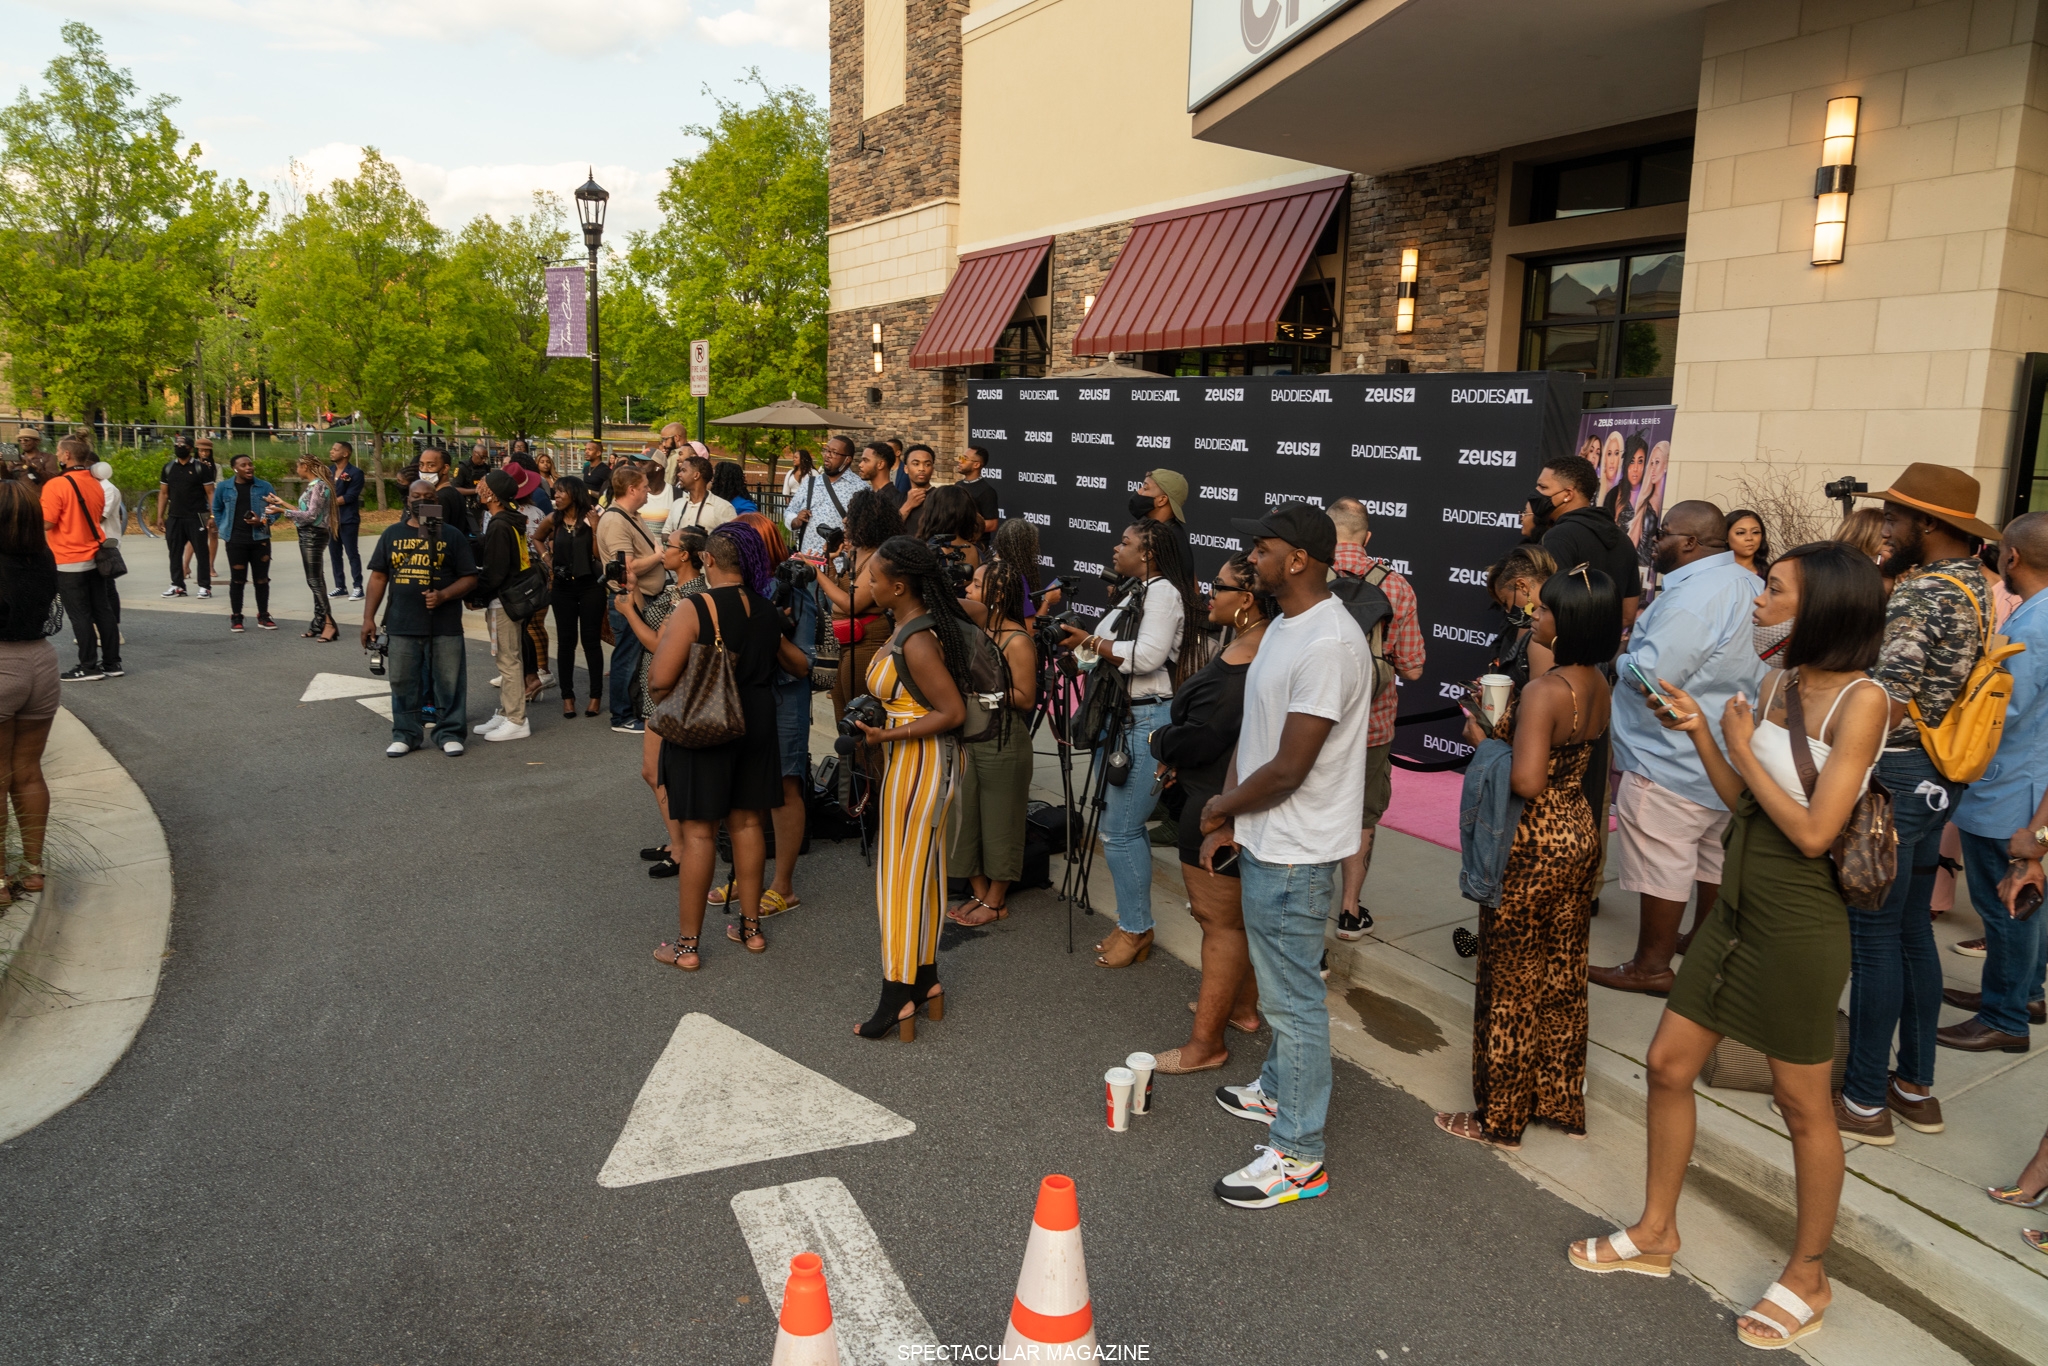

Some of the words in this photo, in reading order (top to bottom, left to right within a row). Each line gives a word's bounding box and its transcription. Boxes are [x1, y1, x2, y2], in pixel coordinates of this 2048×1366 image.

[1019, 389, 1060, 401] BADDIESATL
[1131, 389, 1181, 402] BADDIESATL
[1270, 388, 1333, 403] BADDIESATL
[1450, 388, 1534, 404] BADDIESATL
[1614, 418, 1640, 426] ORIGINAL
[971, 428, 1008, 440] BADDIESATL
[1071, 432, 1115, 446] BADDIESATL
[1194, 437, 1249, 452] BADDIESATL
[1350, 443, 1422, 461] BADDIESATL
[980, 467, 996, 479] eus
[1018, 471, 1058, 485] BADDIESATL
[1442, 507, 1523, 529] BADDIESATL
[1068, 517, 1112, 534] BADDIESATL
[1189, 532, 1243, 552] BADDIESATL
